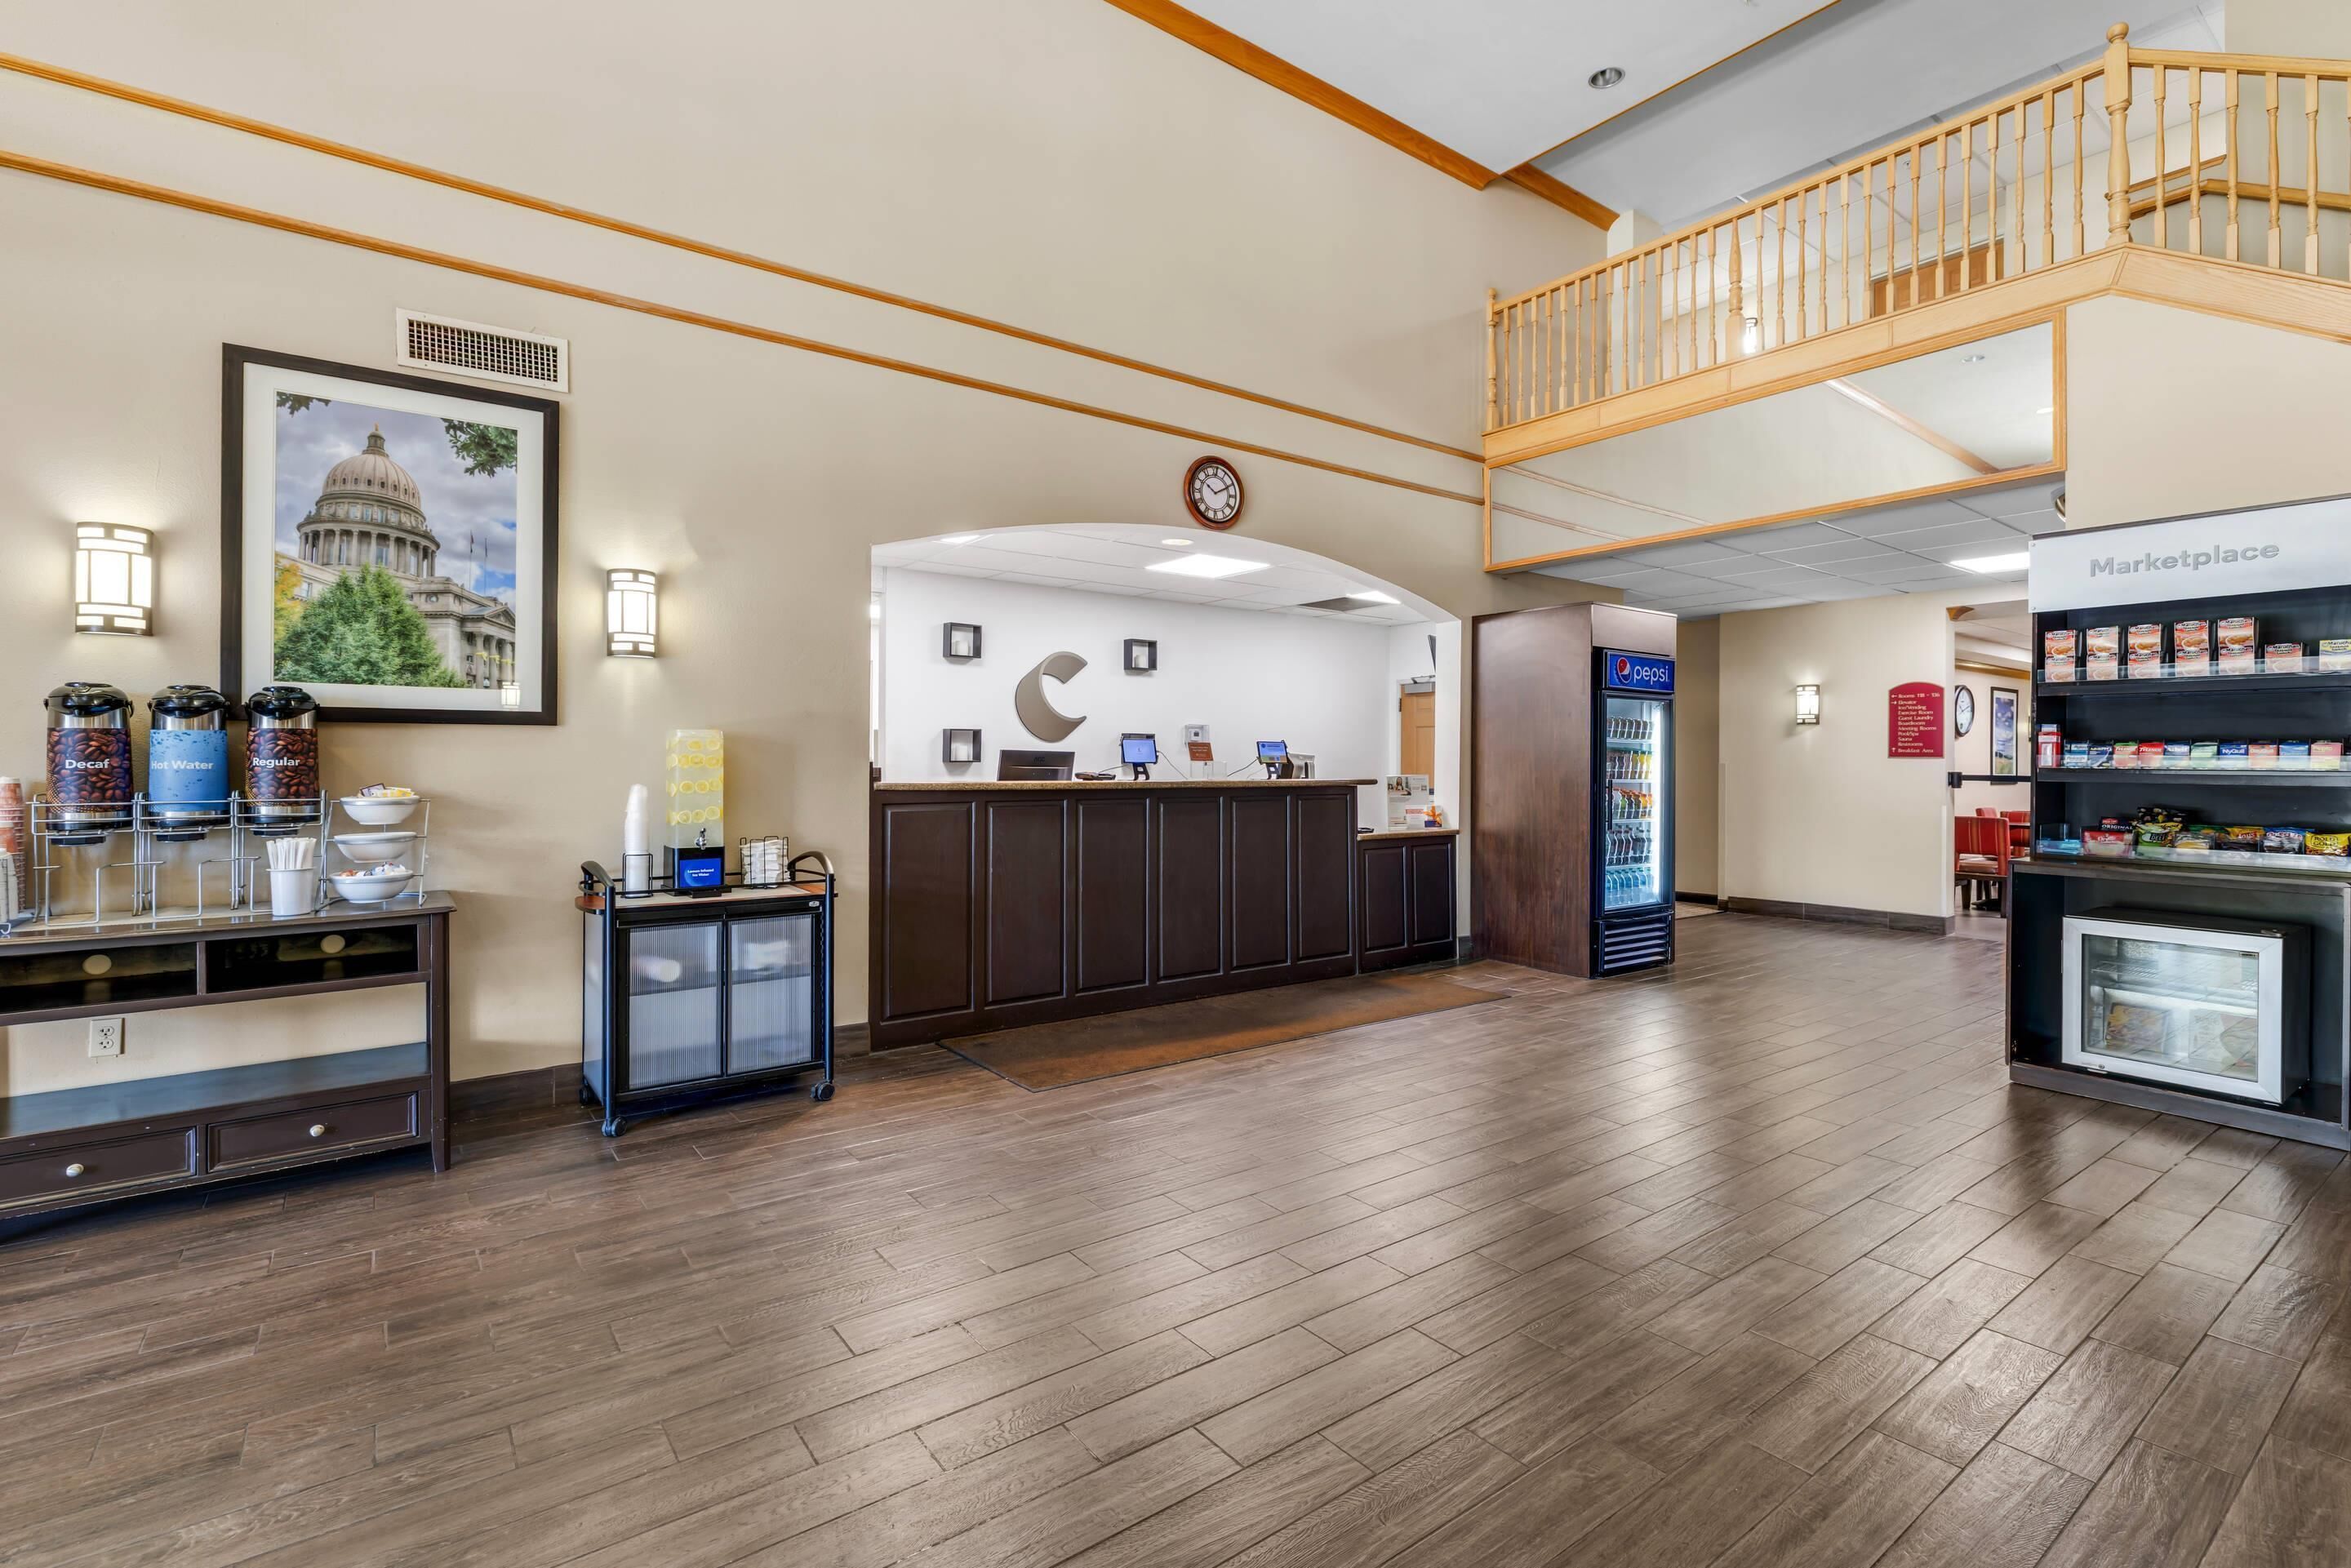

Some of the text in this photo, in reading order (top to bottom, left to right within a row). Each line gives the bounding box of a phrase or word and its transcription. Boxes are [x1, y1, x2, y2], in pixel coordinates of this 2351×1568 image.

[2090, 544, 2280, 577] Marketplace
[1633, 665, 1669, 685] pepsi
[64, 758, 110, 769] Decaf
[151, 760, 214, 770] Hot Water
[252, 757, 300, 768] Regular
